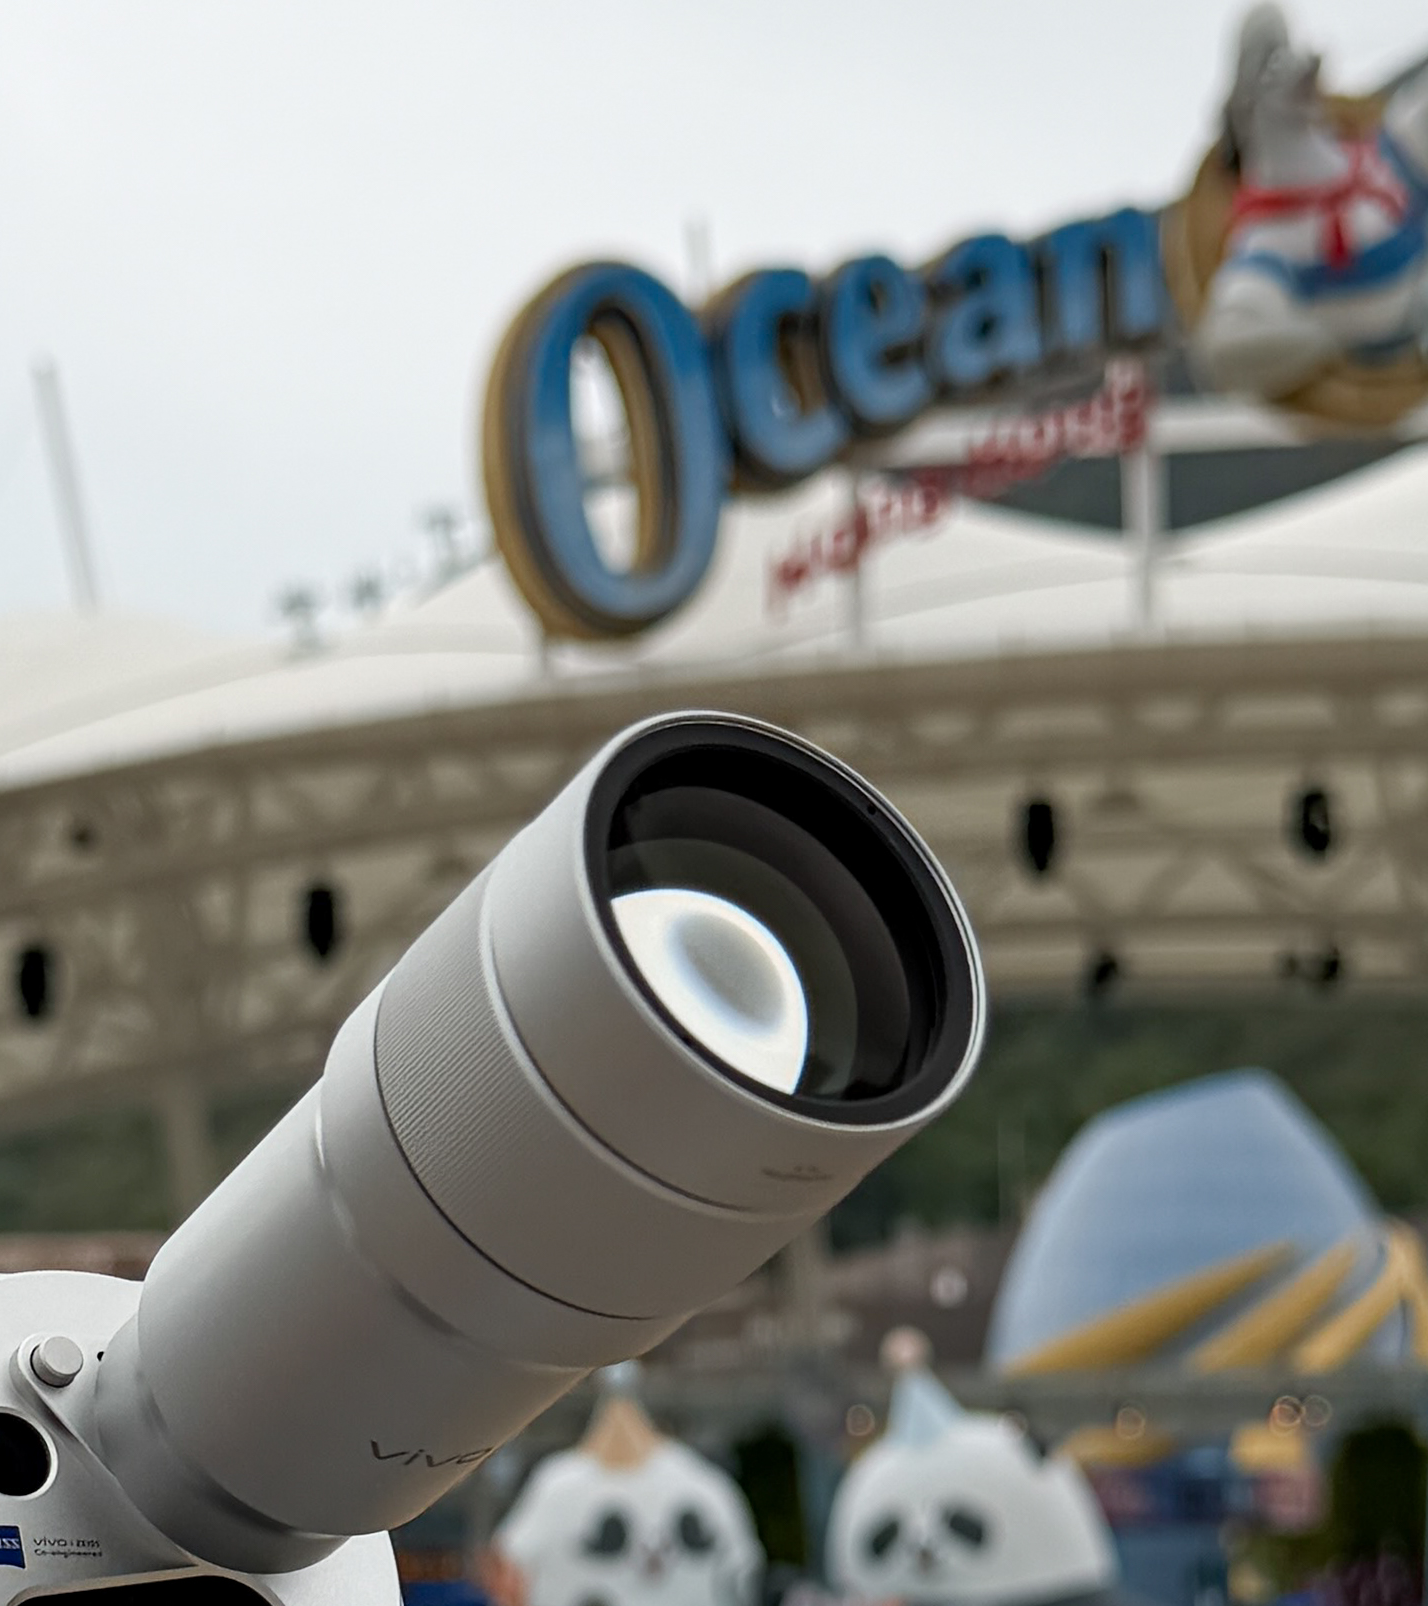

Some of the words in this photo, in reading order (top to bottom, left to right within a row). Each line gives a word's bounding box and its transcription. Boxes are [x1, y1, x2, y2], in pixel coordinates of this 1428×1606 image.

[486, 205, 1167, 636] Ocean
[370, 1439, 495, 1468] vivo
[33, 1536, 67, 1548] vivo
